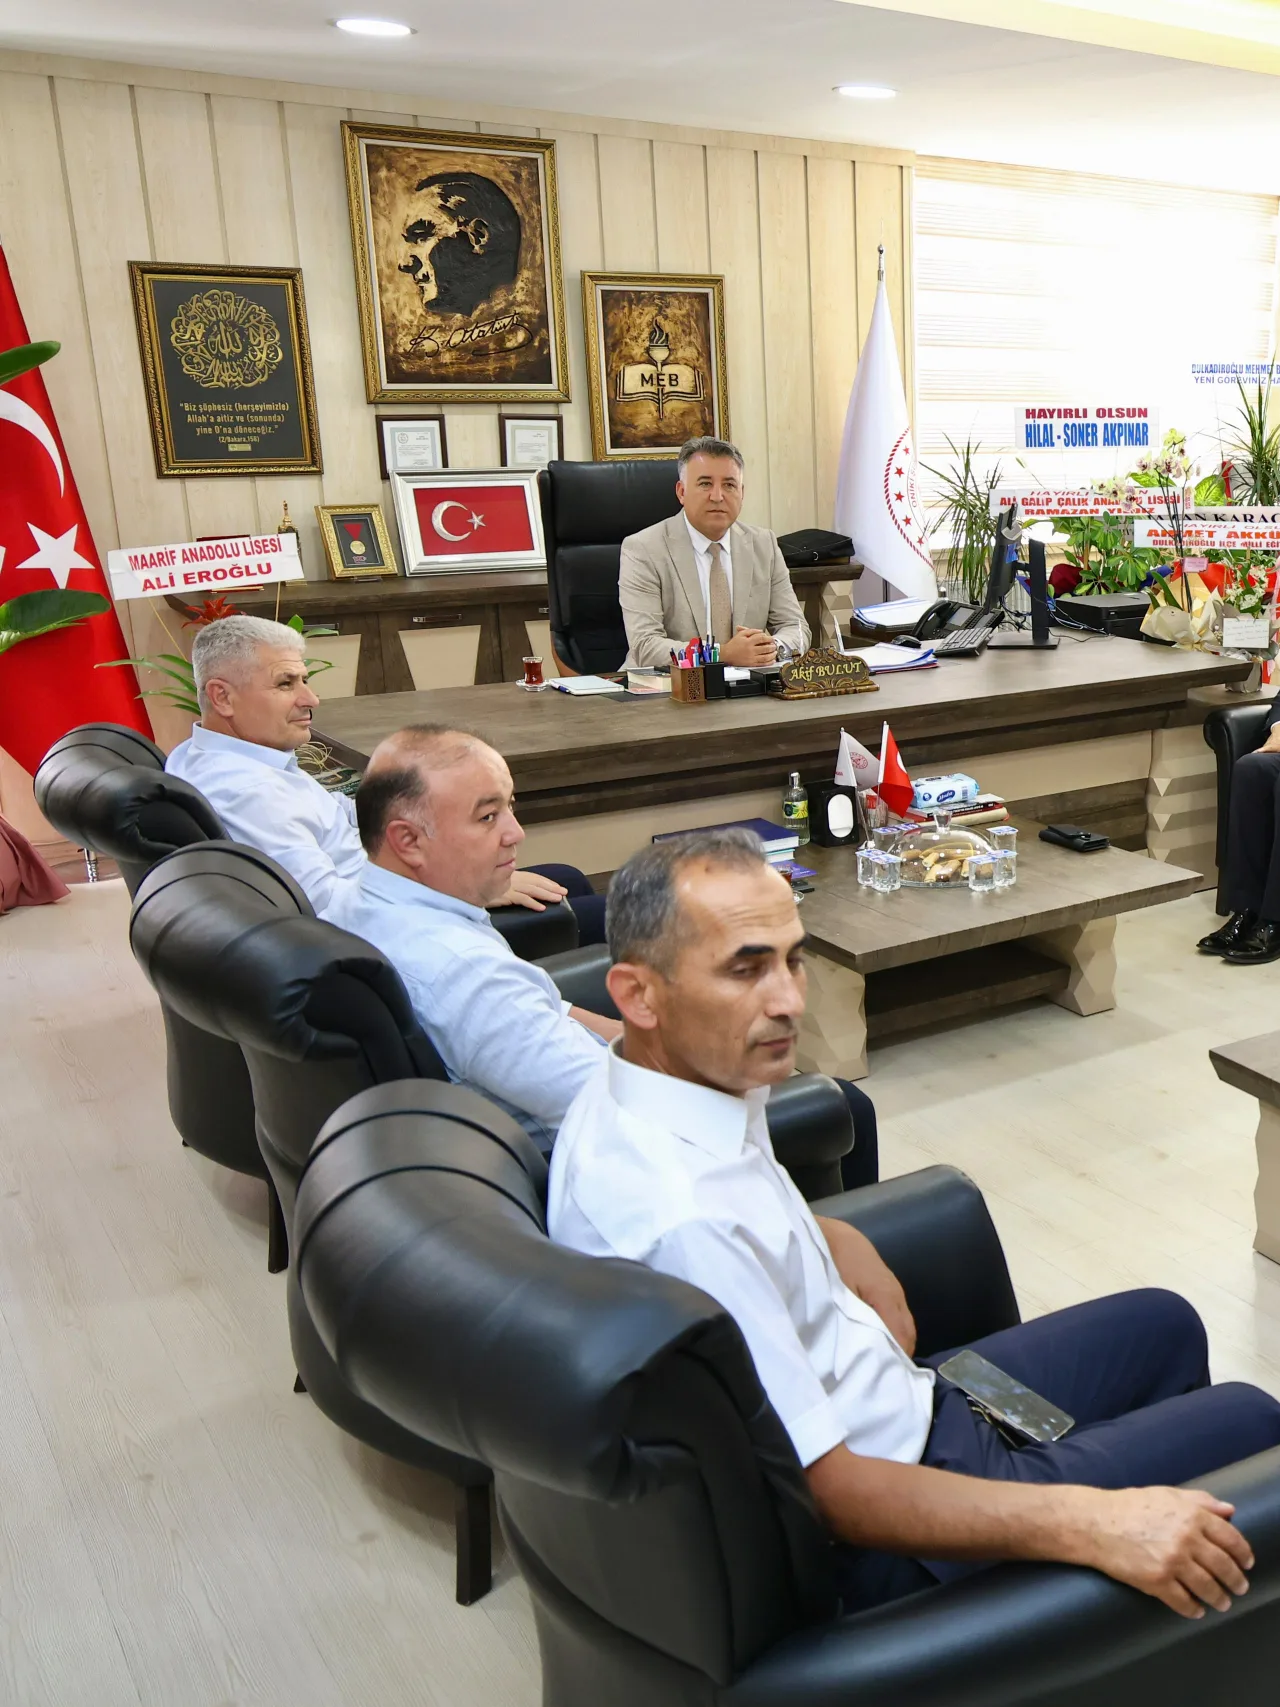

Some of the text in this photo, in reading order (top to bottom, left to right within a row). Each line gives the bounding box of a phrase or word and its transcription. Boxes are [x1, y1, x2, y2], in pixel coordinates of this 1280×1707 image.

[640, 372, 680, 388] MEB
[1025, 408, 1148, 419] HAYIRLI OLSUN
[1025, 419, 1055, 448] HİLAL
[1064, 422, 1098, 448] SONER
[1102, 422, 1149, 447] AKPINAR
[1024, 508, 1100, 516] RAMAZAN
[128, 534, 283, 572] MAARİF ANADOLU LİSESİ
[142, 562, 273, 592] ALİ EROĞLU
[818, 661, 863, 678] BULUT
